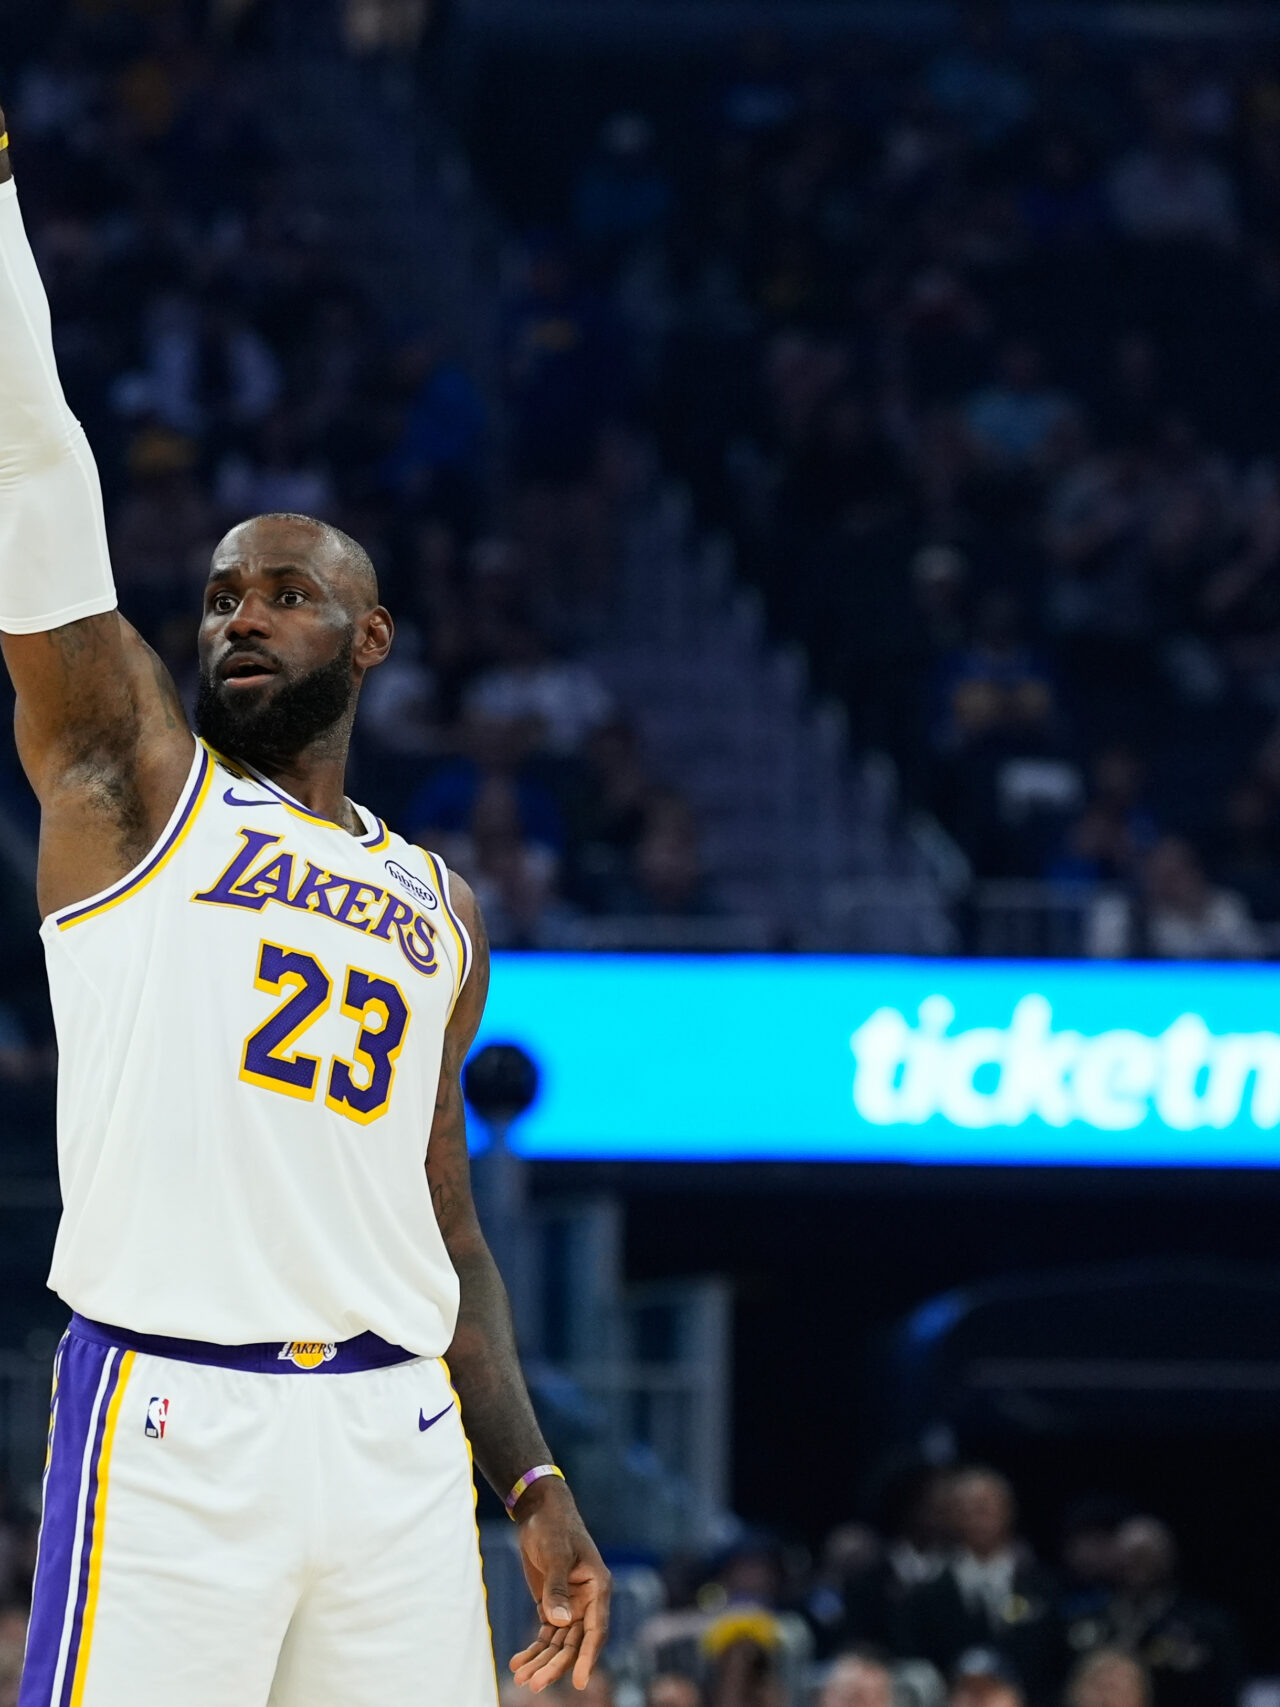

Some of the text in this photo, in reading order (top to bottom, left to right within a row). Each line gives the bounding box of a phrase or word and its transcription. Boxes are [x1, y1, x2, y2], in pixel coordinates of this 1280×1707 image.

[190, 826, 439, 977] LAKERS
[389, 866, 433, 901] bibigo
[238, 938, 411, 1125] 23
[278, 1341, 337, 1361] LAKERS
